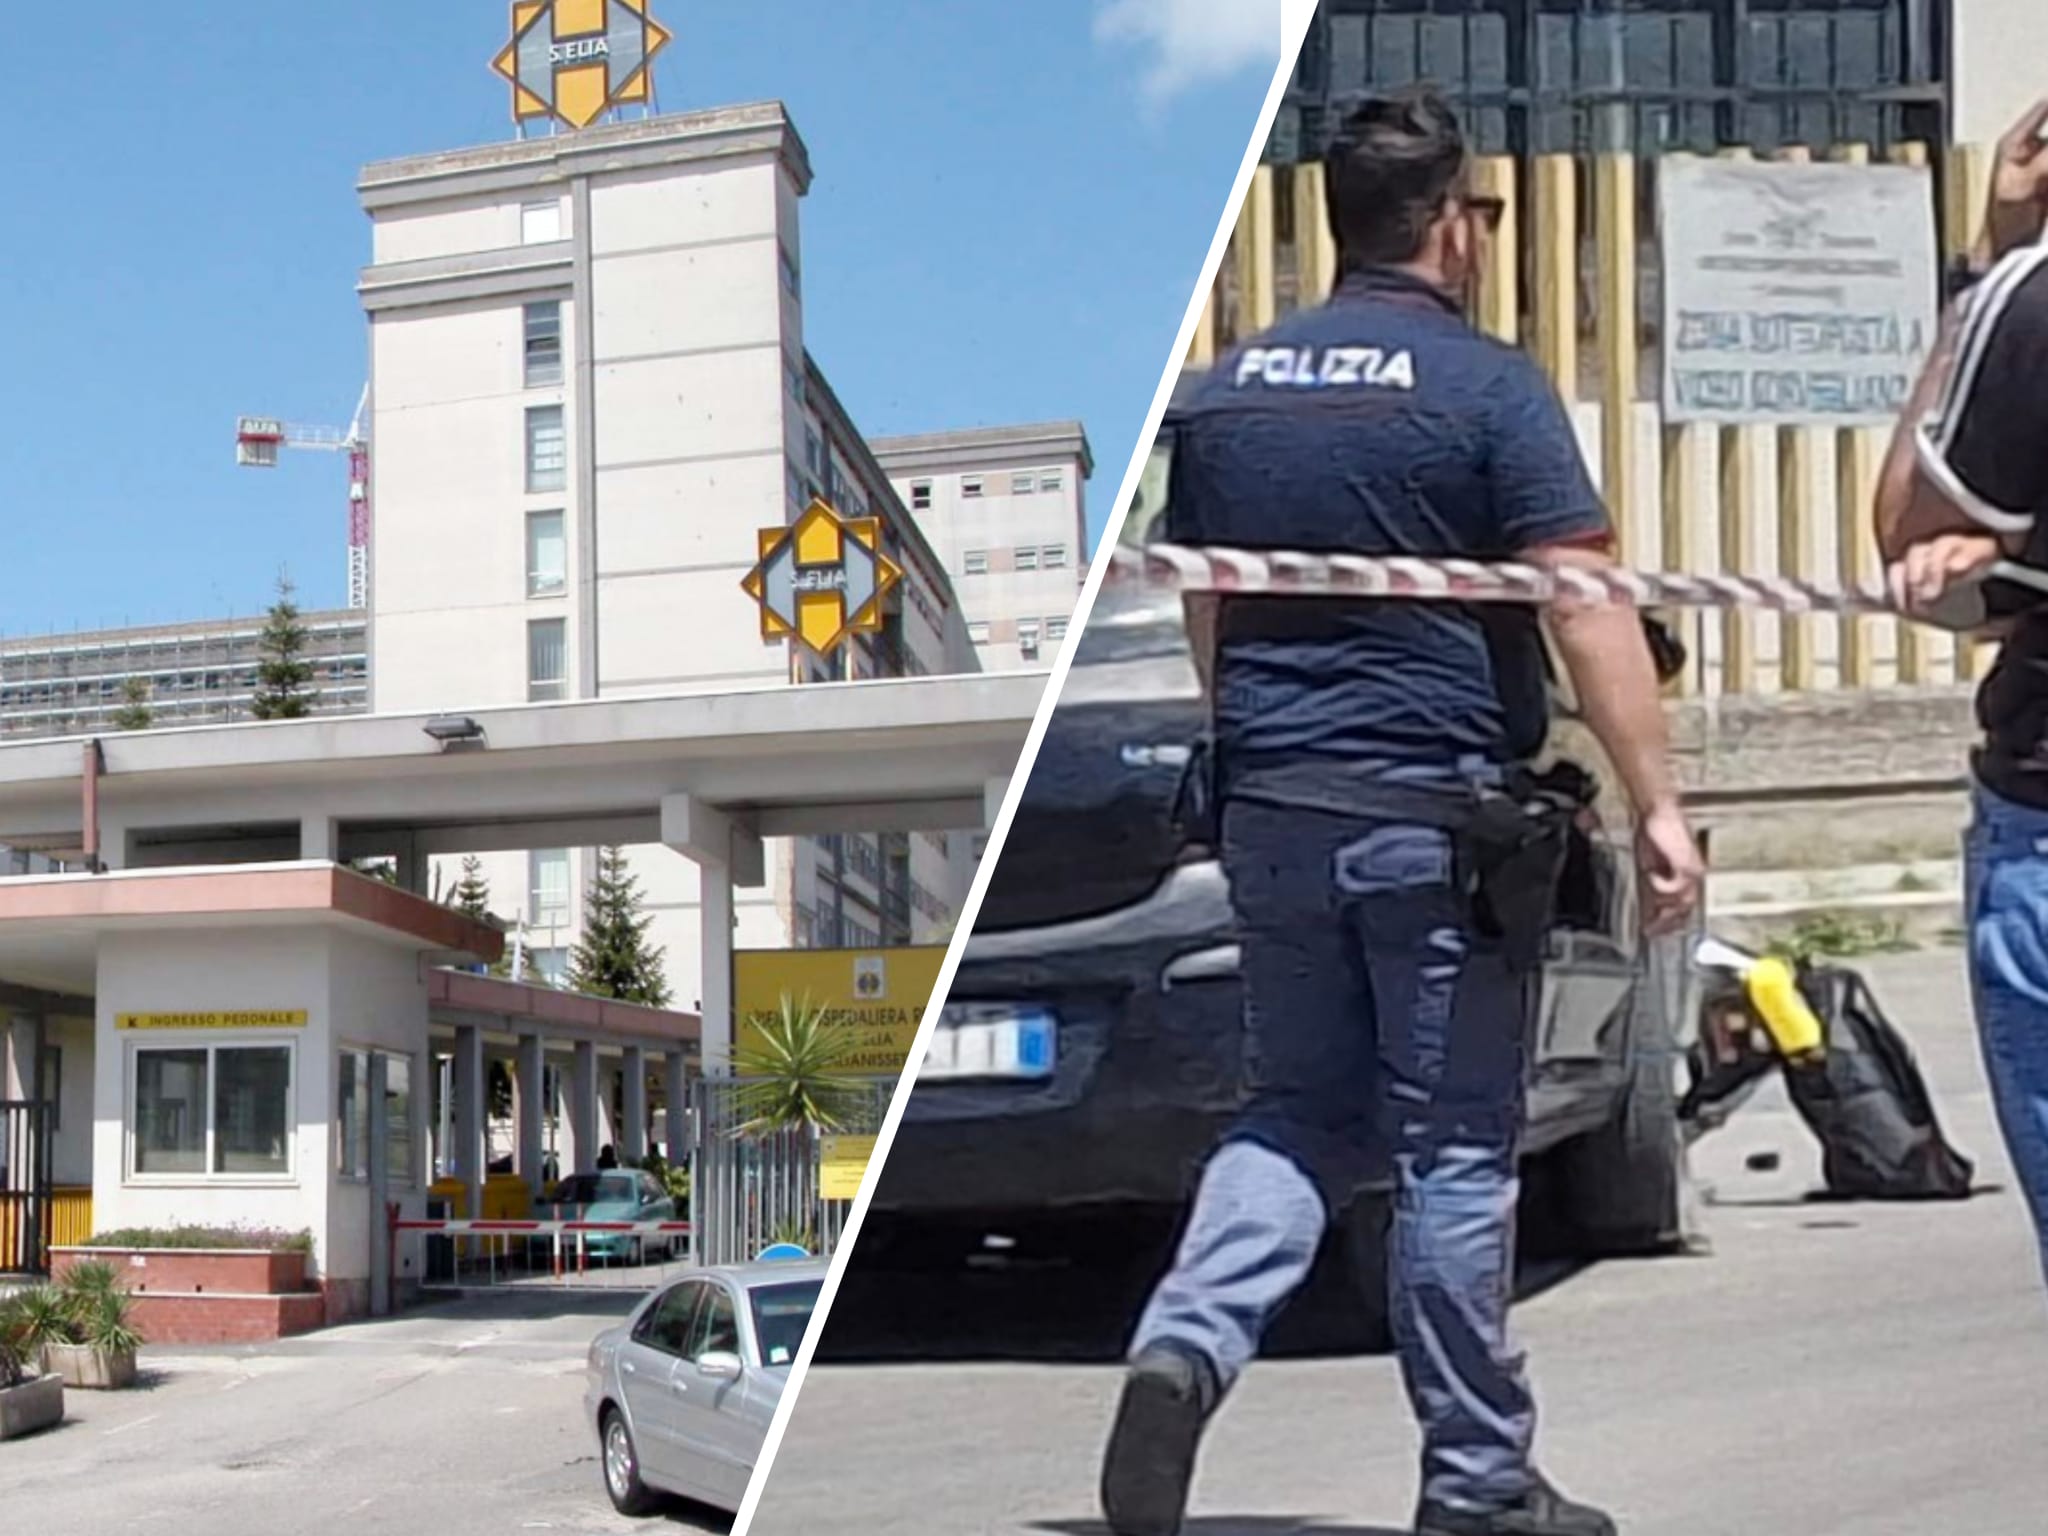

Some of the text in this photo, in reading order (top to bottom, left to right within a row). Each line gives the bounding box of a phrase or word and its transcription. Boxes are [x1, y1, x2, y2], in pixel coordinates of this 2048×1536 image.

[1236, 347, 1415, 389] POLIZIA
[150, 1011, 293, 1026] INGRESSO PEDONALE
